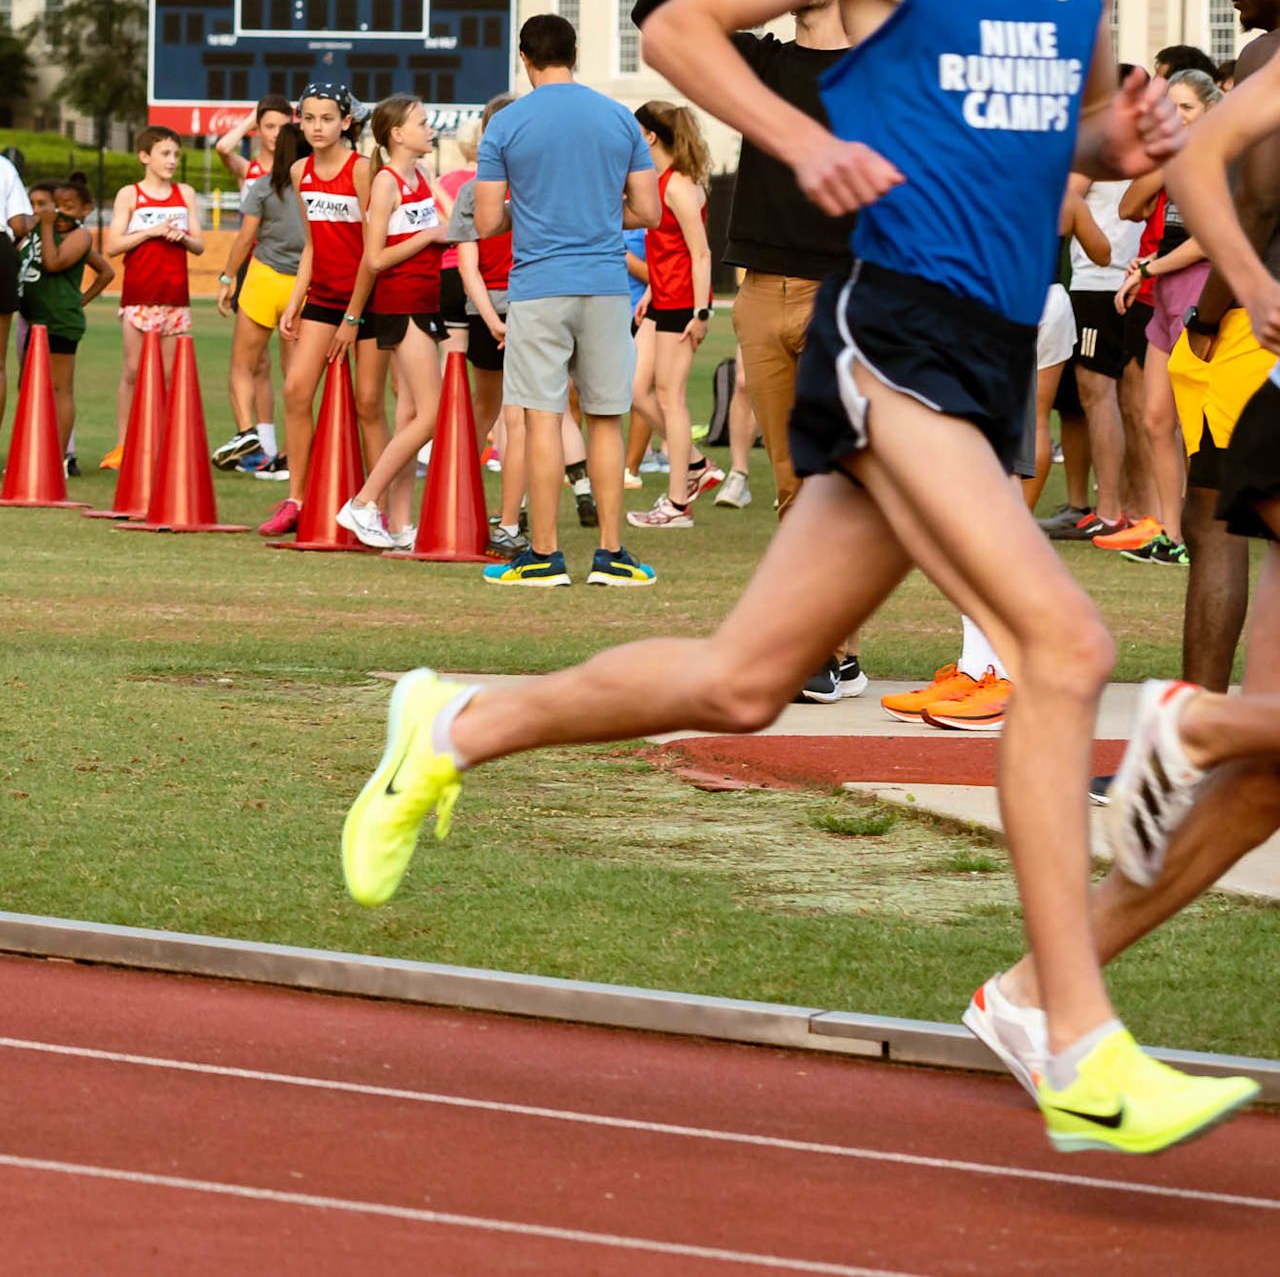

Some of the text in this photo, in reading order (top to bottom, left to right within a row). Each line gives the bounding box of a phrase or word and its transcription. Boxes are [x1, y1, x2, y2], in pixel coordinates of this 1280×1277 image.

[980, 19, 1060, 58] NIKE
[938, 53, 1083, 96] RUNNING
[962, 91, 1070, 132] CAMPS
